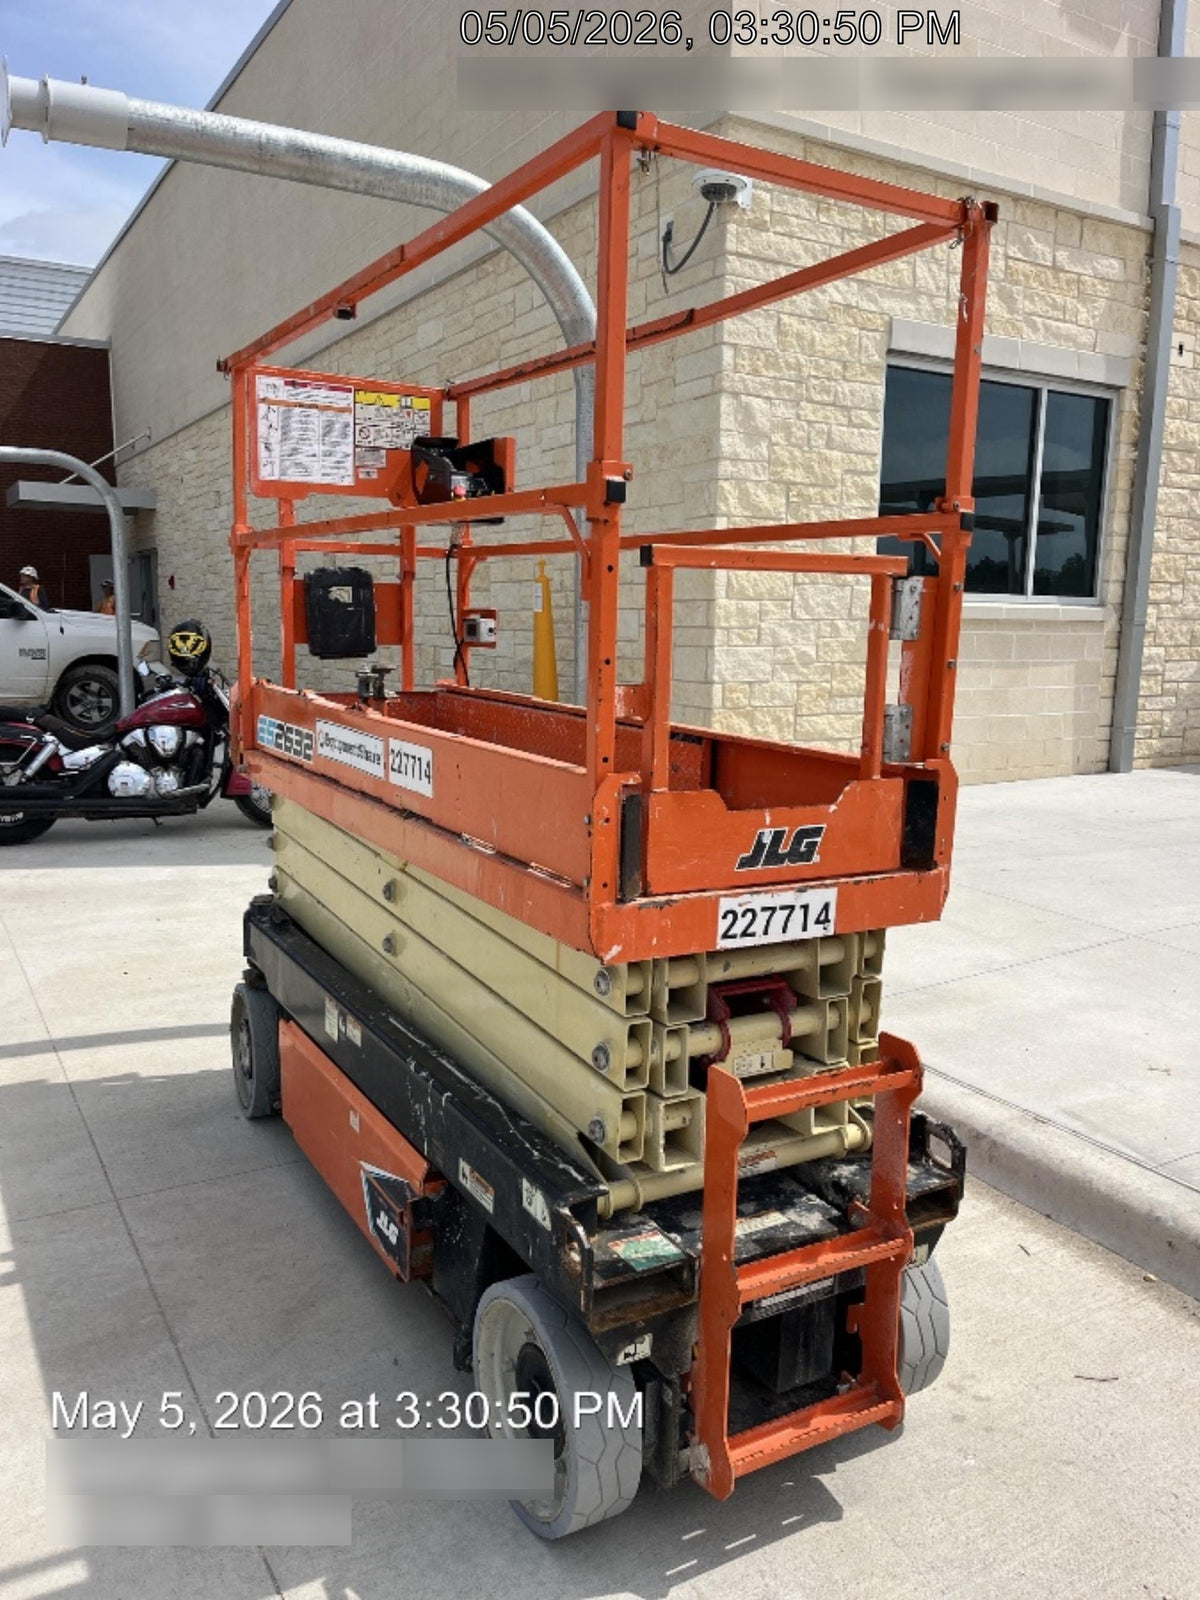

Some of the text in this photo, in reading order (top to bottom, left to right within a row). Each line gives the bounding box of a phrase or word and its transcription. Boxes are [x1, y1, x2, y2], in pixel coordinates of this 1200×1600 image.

[390, 748, 431, 784] 227714
[735, 824, 827, 871] JLG
[720, 901, 831, 939] 227714
[376, 1210, 399, 1246] JLG
